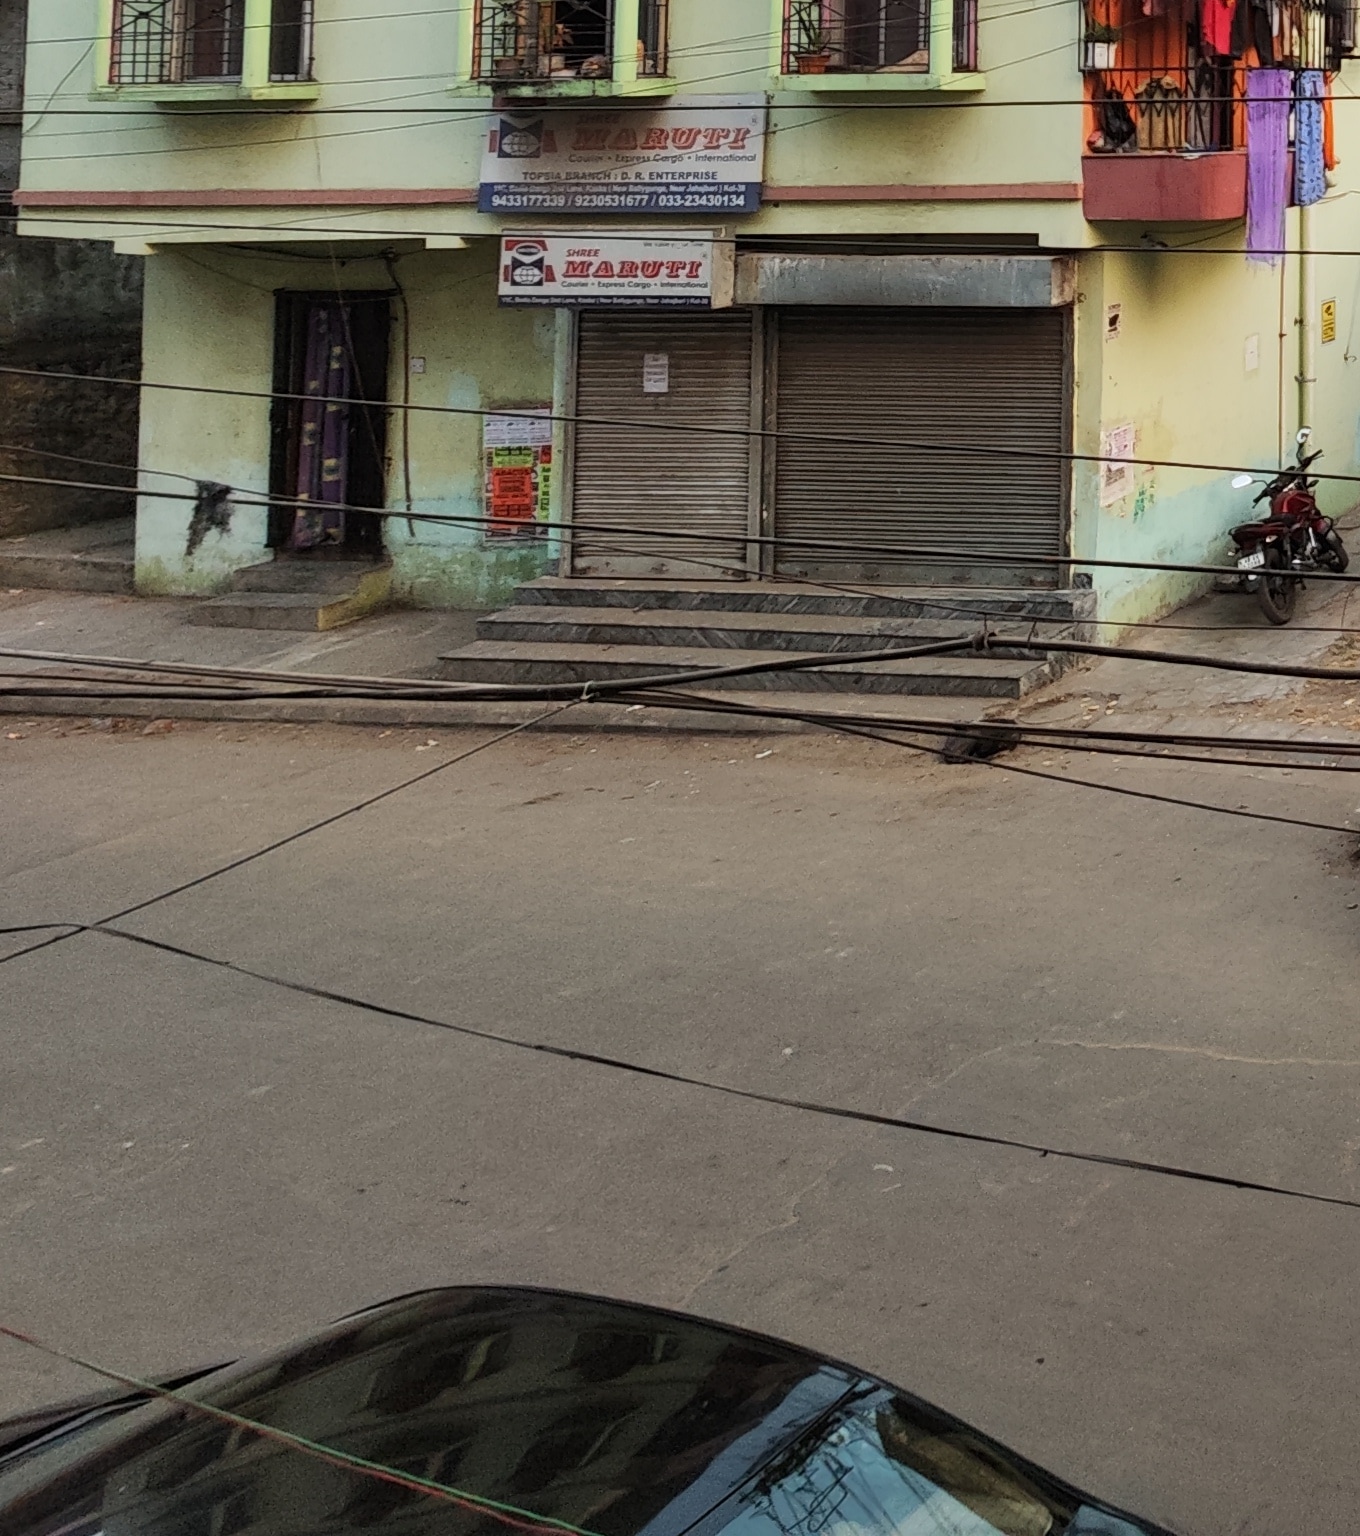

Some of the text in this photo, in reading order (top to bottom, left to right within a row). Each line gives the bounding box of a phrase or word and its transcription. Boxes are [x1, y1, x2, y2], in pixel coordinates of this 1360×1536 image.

[571, 127, 751, 151] MARUTI
[567, 153, 757, 164] Courier Express Cargo International
[522, 171, 563, 181] TOPSIA
[565, 171, 612, 181] BRANCH
[648, 170, 719, 181] ENTERPRISE
[491, 194, 566, 207] 9433177339
[574, 194, 649, 207] 9230531677
[658, 194, 745, 207] 033-23430134
[566, 248, 601, 258] SHREE
[562, 260, 703, 279] MARUTI
[561, 281, 709, 290] Courier Express Cargo International
